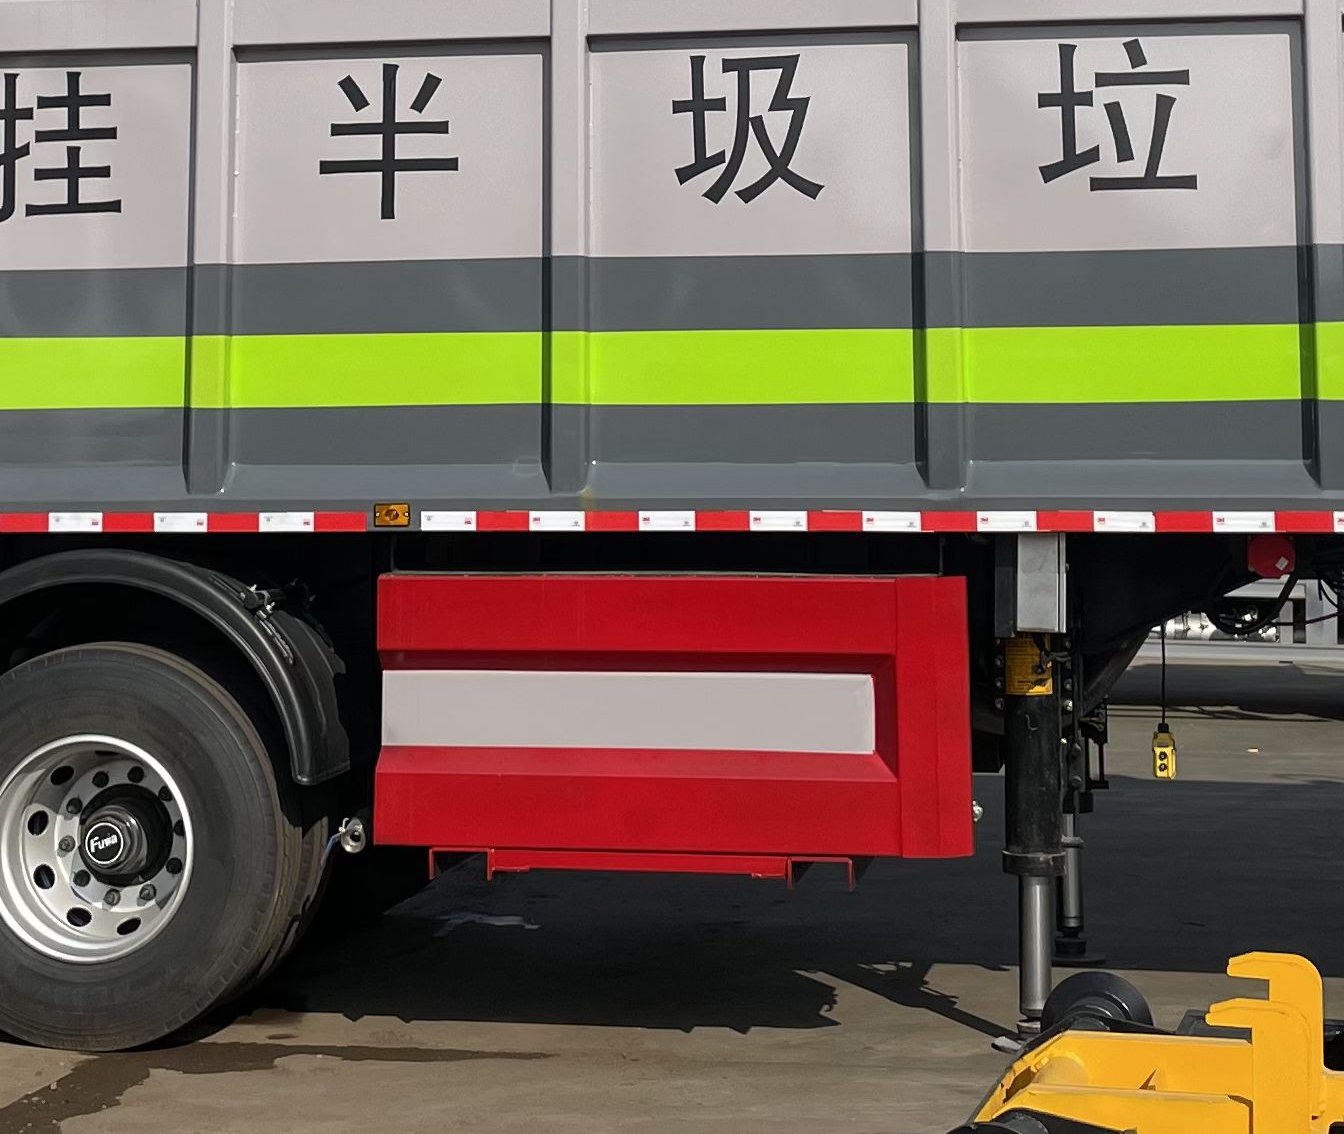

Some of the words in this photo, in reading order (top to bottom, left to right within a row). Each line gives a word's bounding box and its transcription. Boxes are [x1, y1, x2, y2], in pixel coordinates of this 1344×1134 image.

[320, 64, 458, 219] 半
[672, 55, 822, 203] 圾
[1038, 39, 1197, 191] 垃
